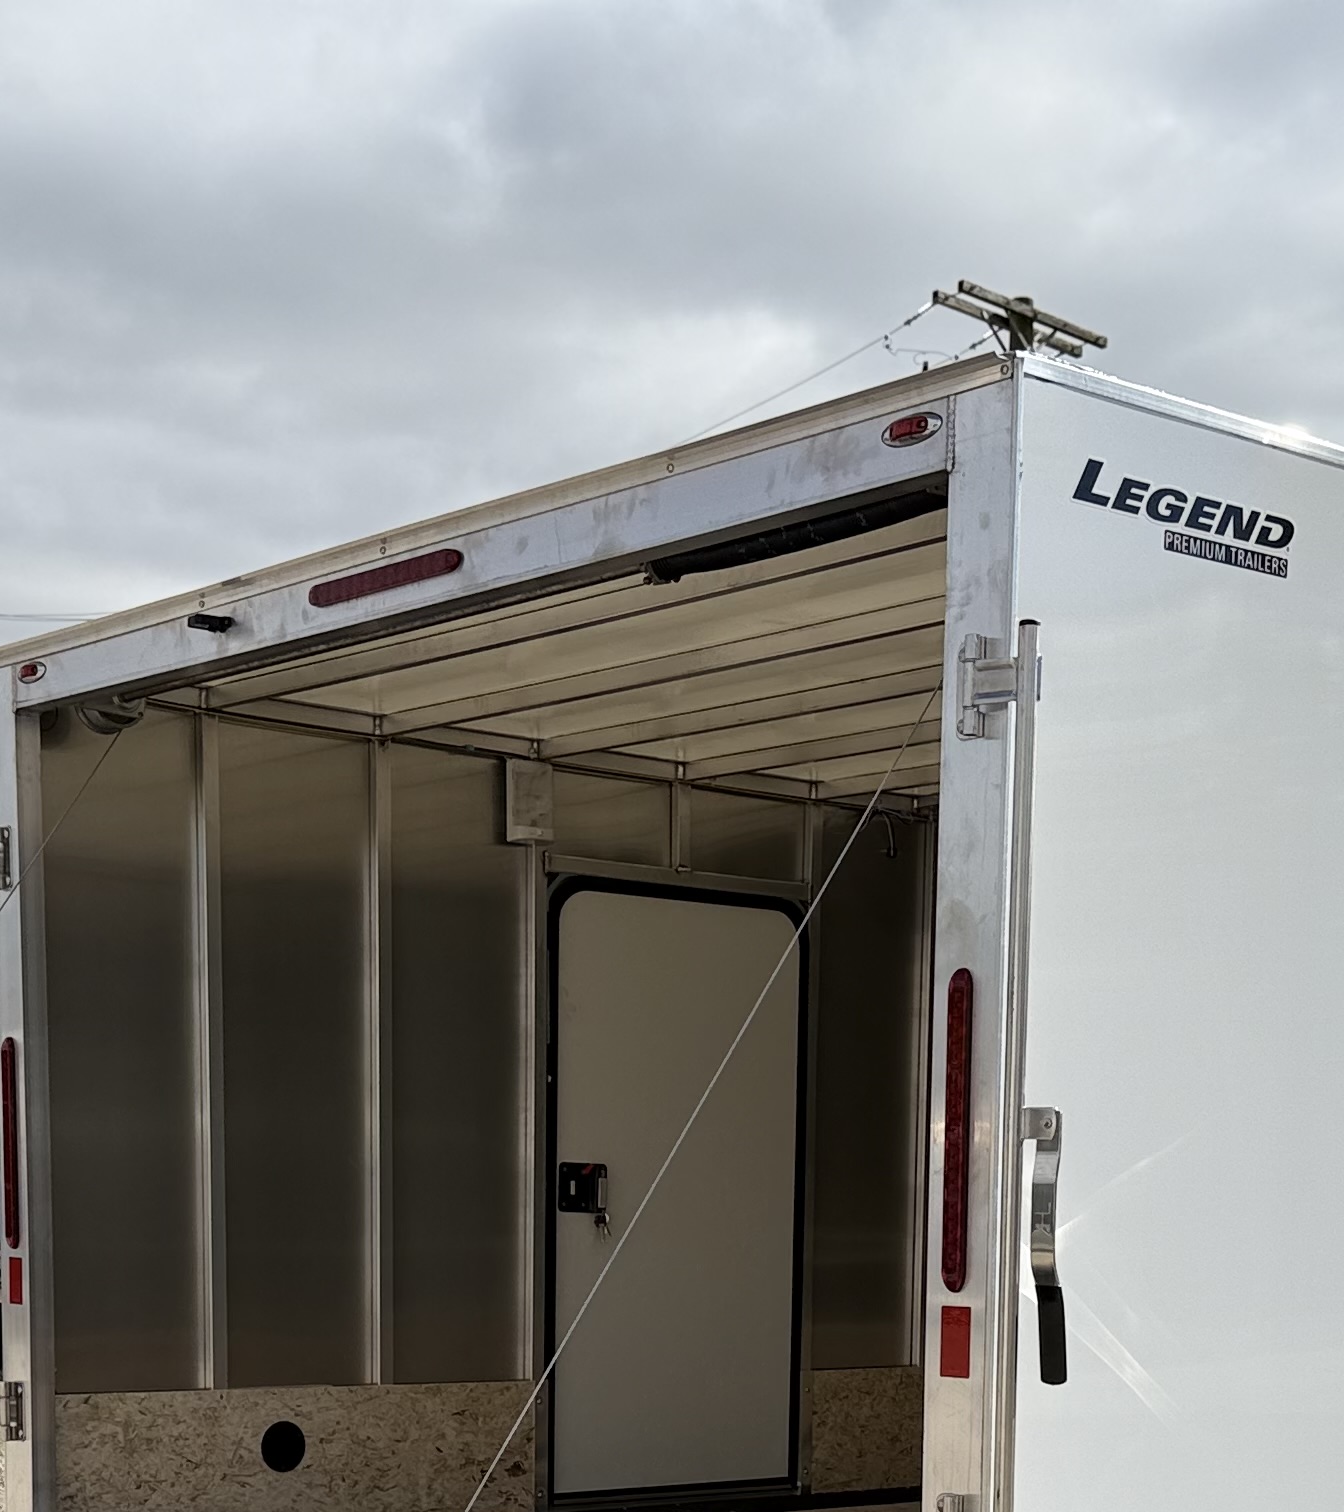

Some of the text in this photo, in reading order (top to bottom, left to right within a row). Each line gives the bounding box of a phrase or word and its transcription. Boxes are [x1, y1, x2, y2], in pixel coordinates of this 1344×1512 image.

[1072, 458, 1295, 549] LEGEND
[1165, 532, 1288, 577] PREMIUM TRAILERS
